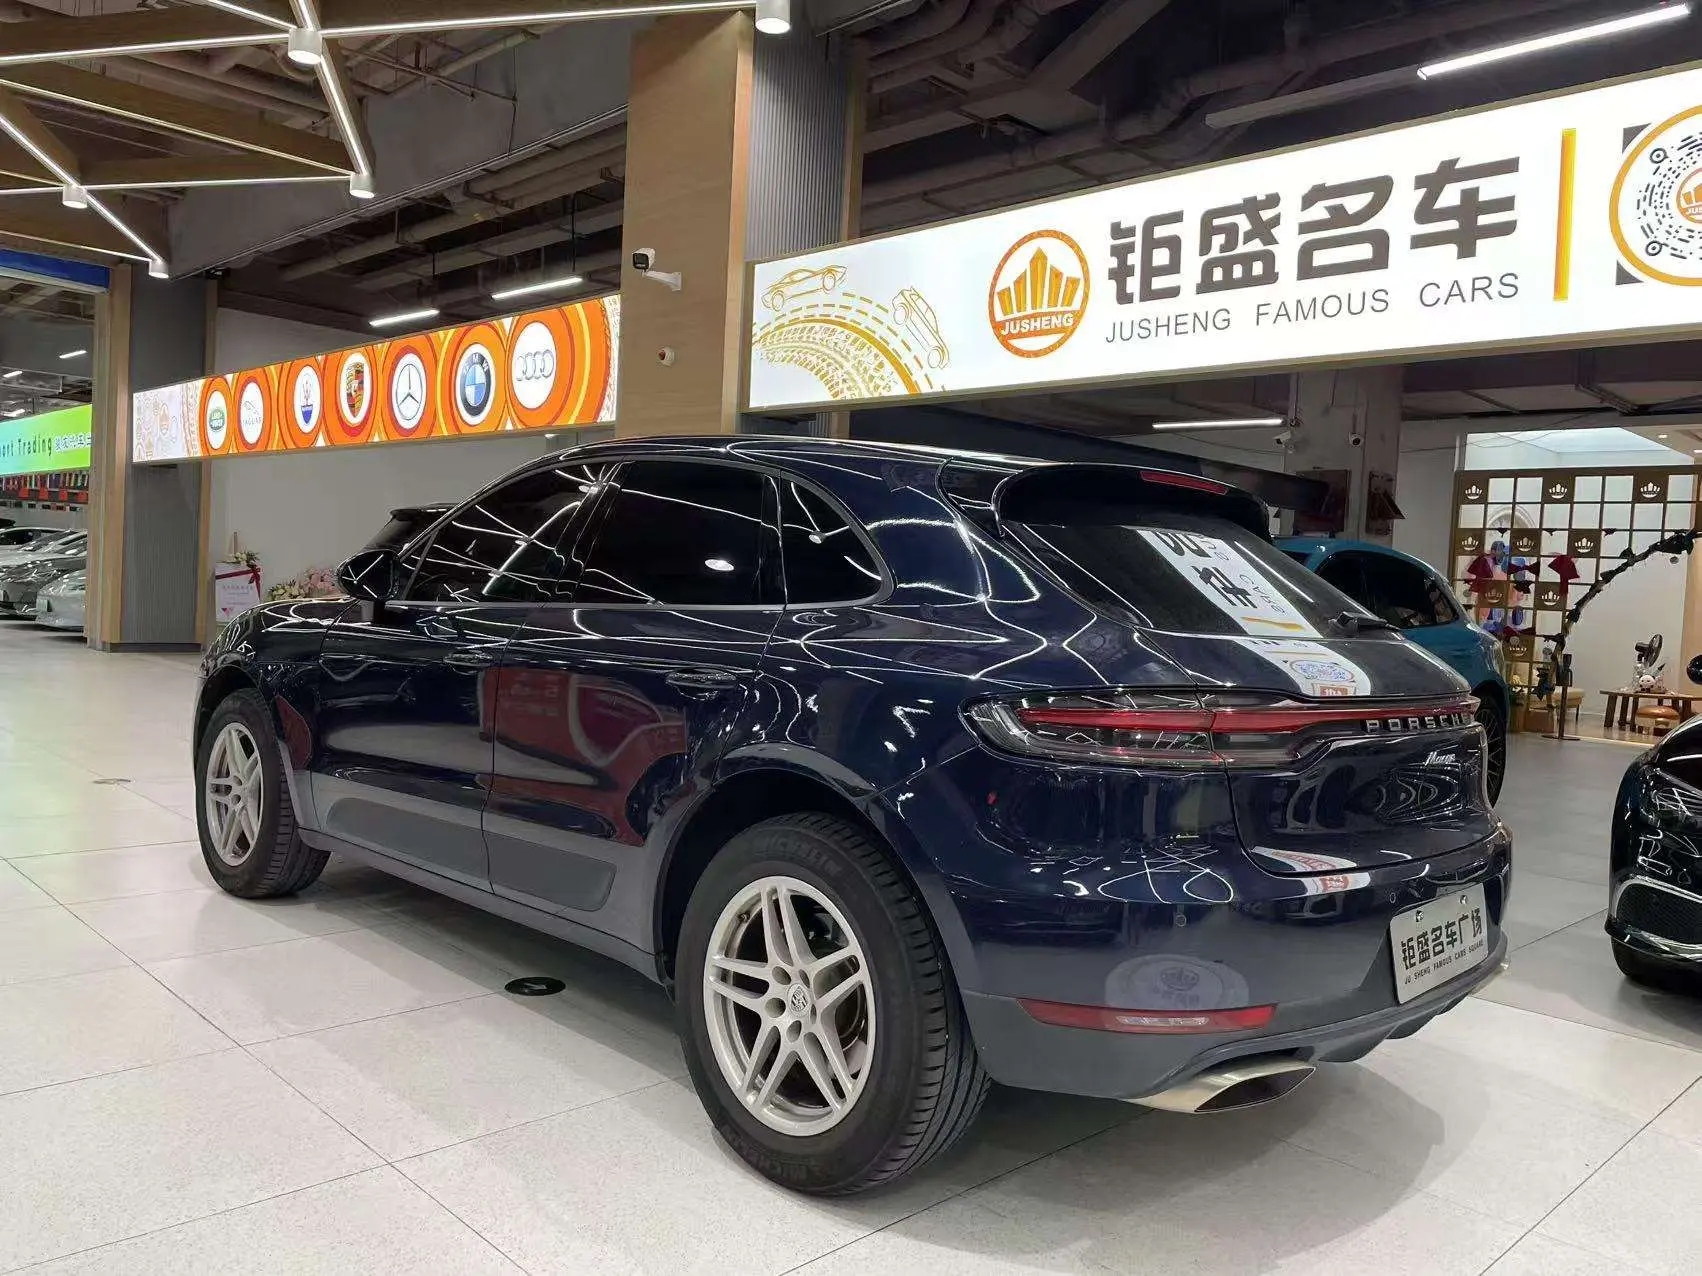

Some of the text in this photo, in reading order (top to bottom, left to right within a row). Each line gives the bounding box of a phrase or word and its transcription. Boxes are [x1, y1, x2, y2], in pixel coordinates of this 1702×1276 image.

[1107, 156, 1520, 305] 钜盛名车
[1106, 272, 1520, 343] JUSHENG FAMOUS CARS
[1001, 314, 1074, 336] JUSHENG
[18, 435, 52, 457] Trading
[1366, 712, 1473, 733] PORSCHE
